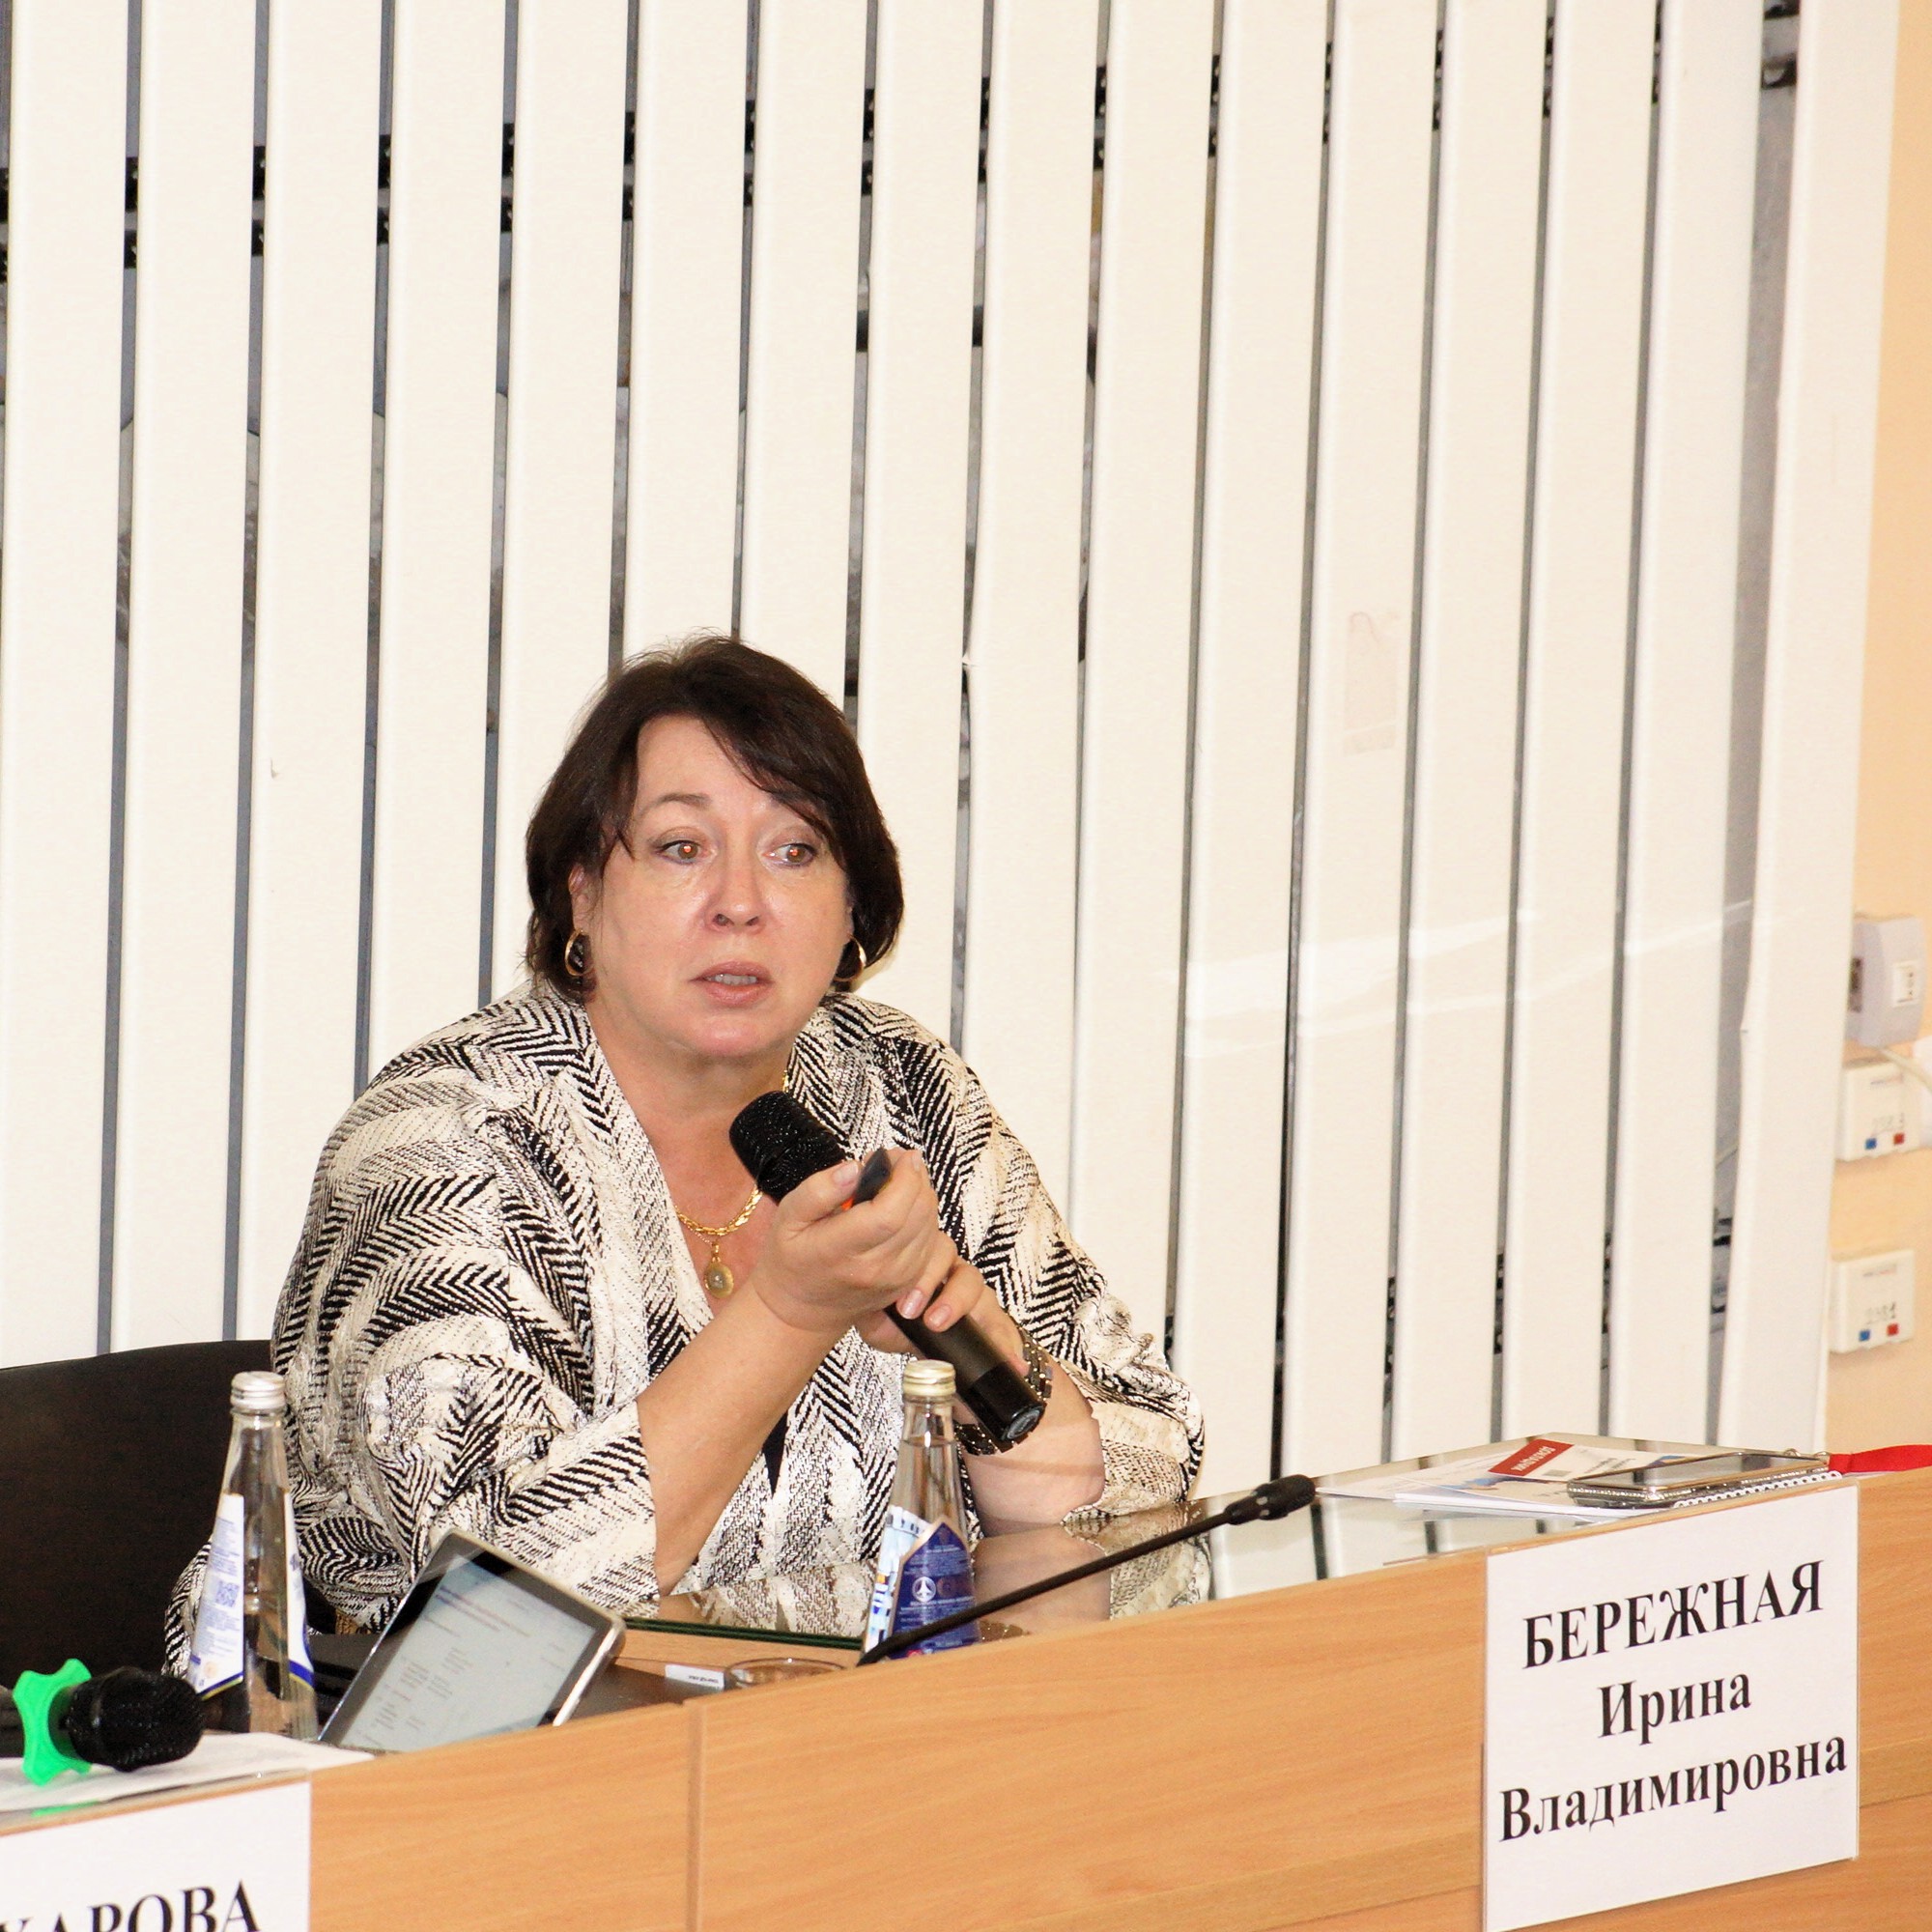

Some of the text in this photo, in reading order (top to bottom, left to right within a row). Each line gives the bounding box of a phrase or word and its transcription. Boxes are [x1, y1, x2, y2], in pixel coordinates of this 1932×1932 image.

[1522, 1559, 1824, 1669] БЕРЕЖНАЯ
[1598, 1672, 1751, 1746] Ирина
[1499, 1735, 1847, 1842] Владимировна
[0, 1880, 259, 1932] РОВА
